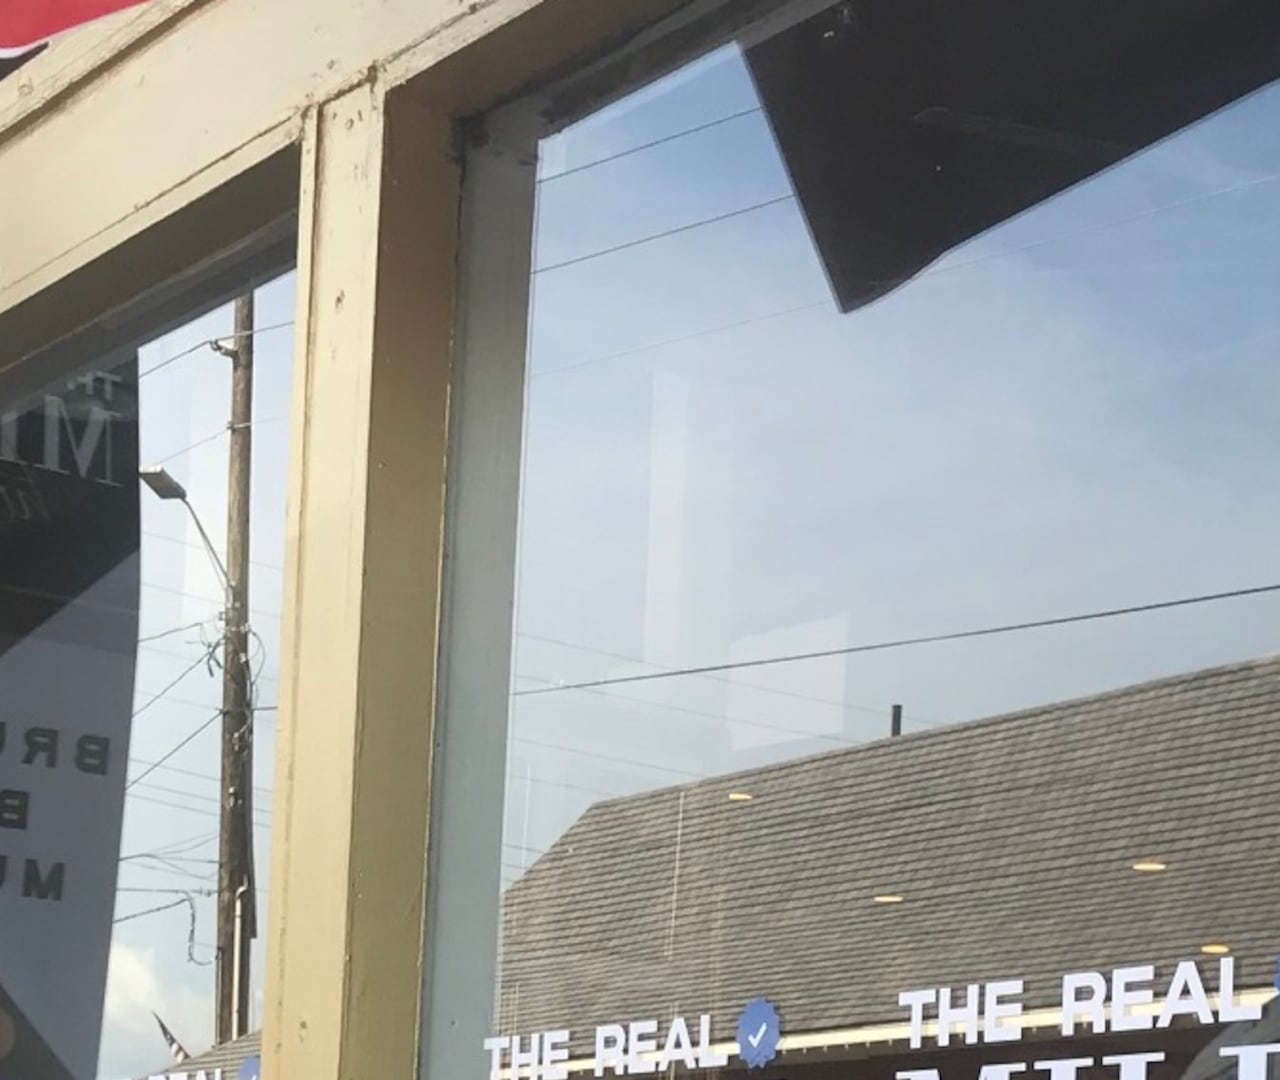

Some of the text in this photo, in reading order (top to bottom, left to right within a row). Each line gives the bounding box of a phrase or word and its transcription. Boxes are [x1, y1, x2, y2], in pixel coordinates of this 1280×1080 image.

[898, 956, 1264, 1049] THE REAL
[594, 1013, 729, 1078] REAL
